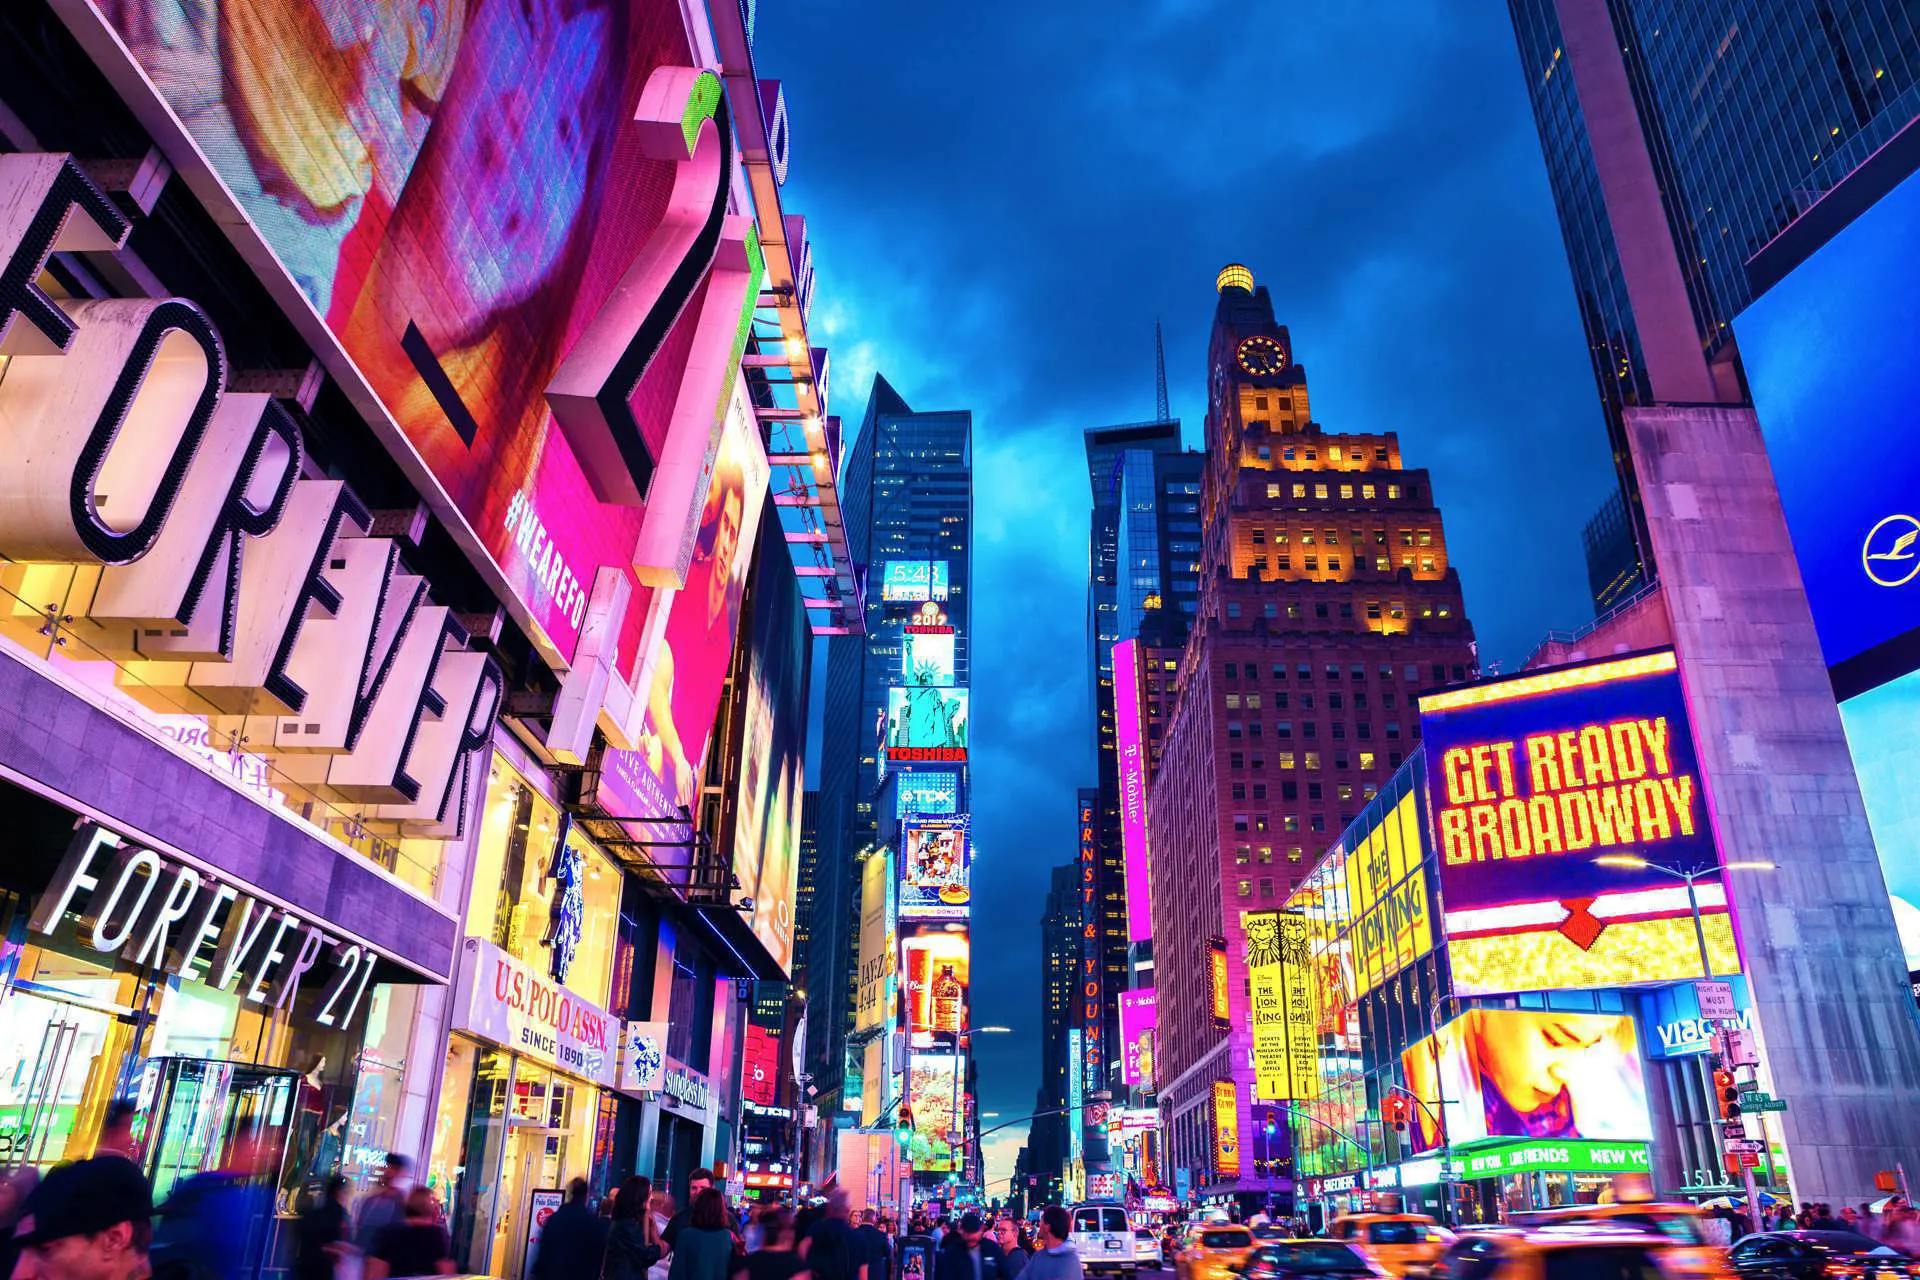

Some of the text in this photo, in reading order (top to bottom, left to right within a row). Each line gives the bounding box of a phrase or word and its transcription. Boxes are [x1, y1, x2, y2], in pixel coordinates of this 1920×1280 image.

[912, 614, 948, 626] 2017
[905, 626, 954, 635] TOSHIBA
[888, 748, 967, 761] TOSHIBA
[1443, 716, 1670, 804] GET READY
[913, 789, 952, 802] TDK
[1440, 775, 1695, 865] BROADWAY
[1082, 808, 1095, 904] ERNST
[1367, 850, 1388, 889] THE
[43, 826, 378, 1031] FOREVER 21
[1084, 924, 1096, 938] &
[1354, 879, 1422, 974] LION KING
[1258, 986, 1274, 995] THE
[1697, 985, 1731, 993] RIGHT LANE
[495, 959, 608, 1053] U.S. POLO ASSN.
[1255, 996, 1278, 1009] LION
[1705, 996, 1726, 1005] MUST
[1085, 959, 1100, 1064] YOUNG
[1256, 1010, 1281, 1025] KING
[1702, 1007, 1737, 1015] TURN RIGHT
[521, 1027, 584, 1068] SINCE 1890
[666, 1068, 698, 1108] sunglass
[1216, 1086, 1236, 1098] BUBBA
[1323, 1175, 1356, 1193] SKECHERS
[1682, 1169, 1730, 1187] 1515
